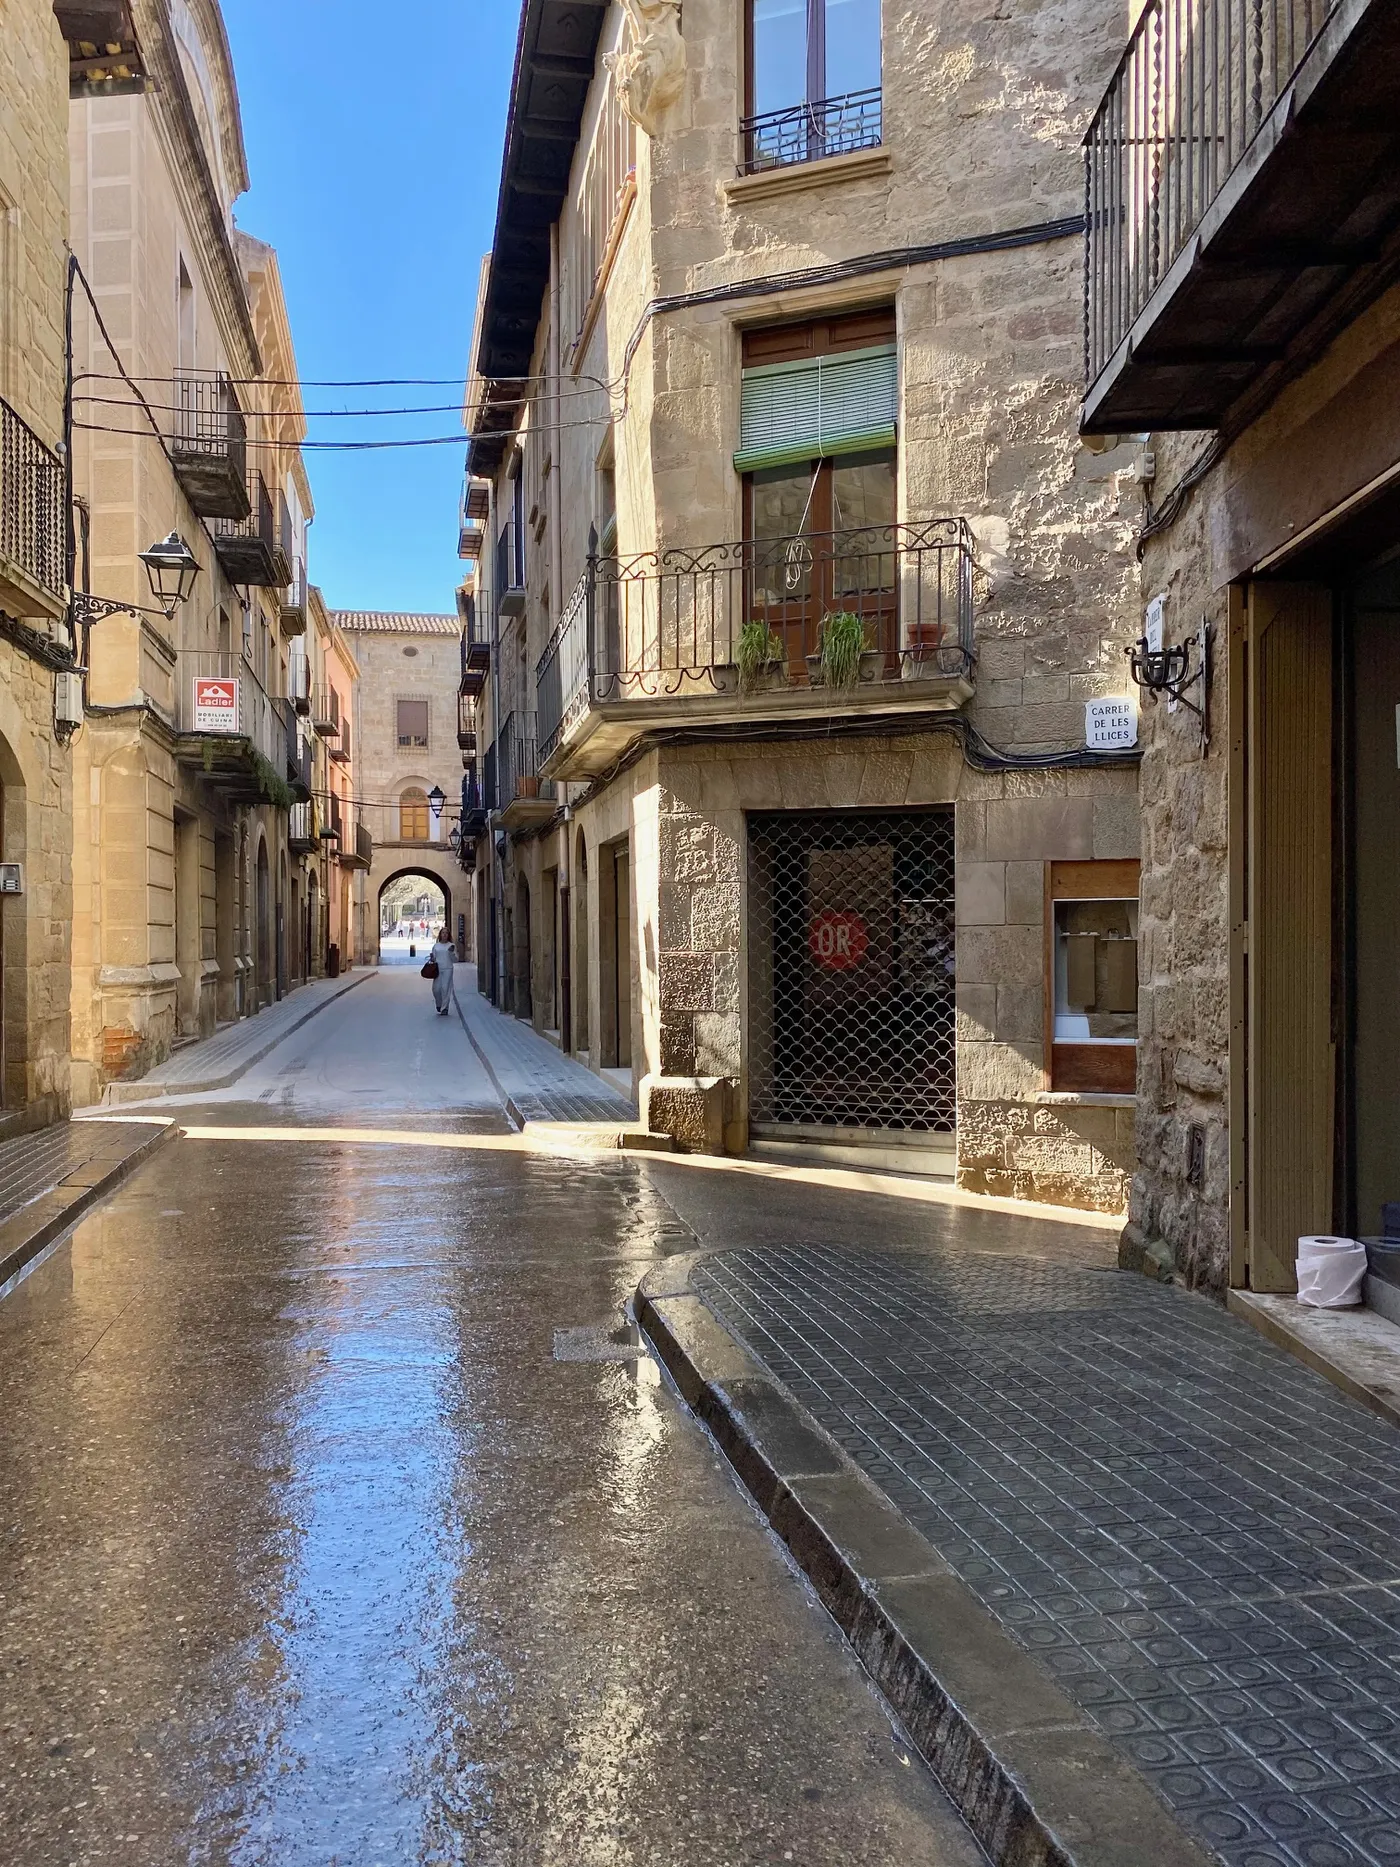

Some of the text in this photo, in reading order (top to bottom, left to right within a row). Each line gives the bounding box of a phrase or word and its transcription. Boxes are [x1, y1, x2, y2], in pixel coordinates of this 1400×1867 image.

[198, 697, 233, 706] Ladier
[1091, 705, 1130, 716] CARRER
[1094, 717, 1129, 729] DE LES
[1095, 730, 1129, 741] LLICES
[818, 925, 851, 956] OR
